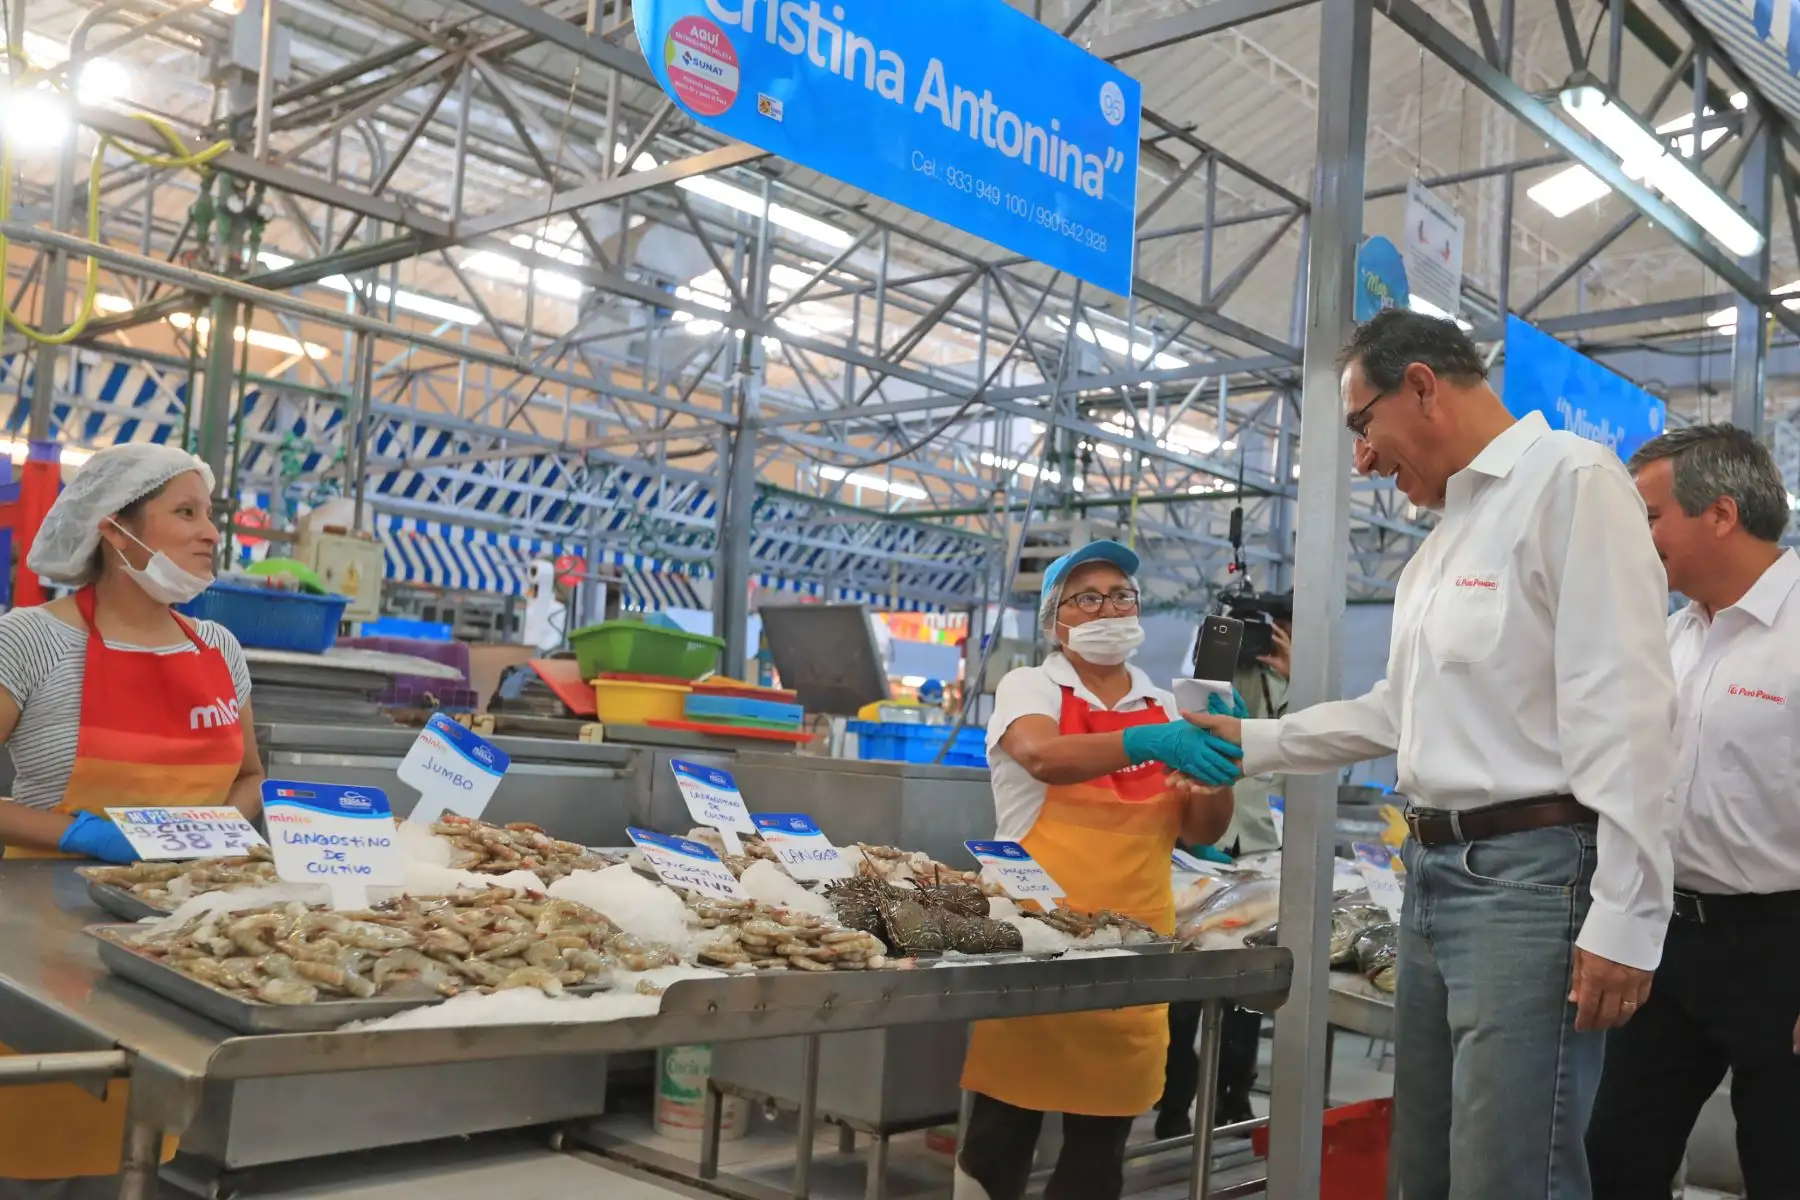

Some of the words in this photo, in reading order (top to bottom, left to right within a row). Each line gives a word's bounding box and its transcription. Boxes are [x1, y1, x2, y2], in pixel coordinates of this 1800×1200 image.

[690, 25, 719, 47] AQUÍ
[692, 56, 724, 77] SUNAT
[946, 166, 973, 193] 933
[975, 179, 1000, 206] 949
[1005, 192, 1028, 218] 100
[1036, 206, 1061, 232] 990
[1061, 218, 1084, 243] 642
[1085, 228, 1108, 253] 928
[421, 755, 474, 791] JUMBO
[156, 821, 252, 833] CULTIVO
[156, 832, 213, 851] 38
[323, 849, 346, 861] DE
[306, 861, 373, 875] CULTIVO
